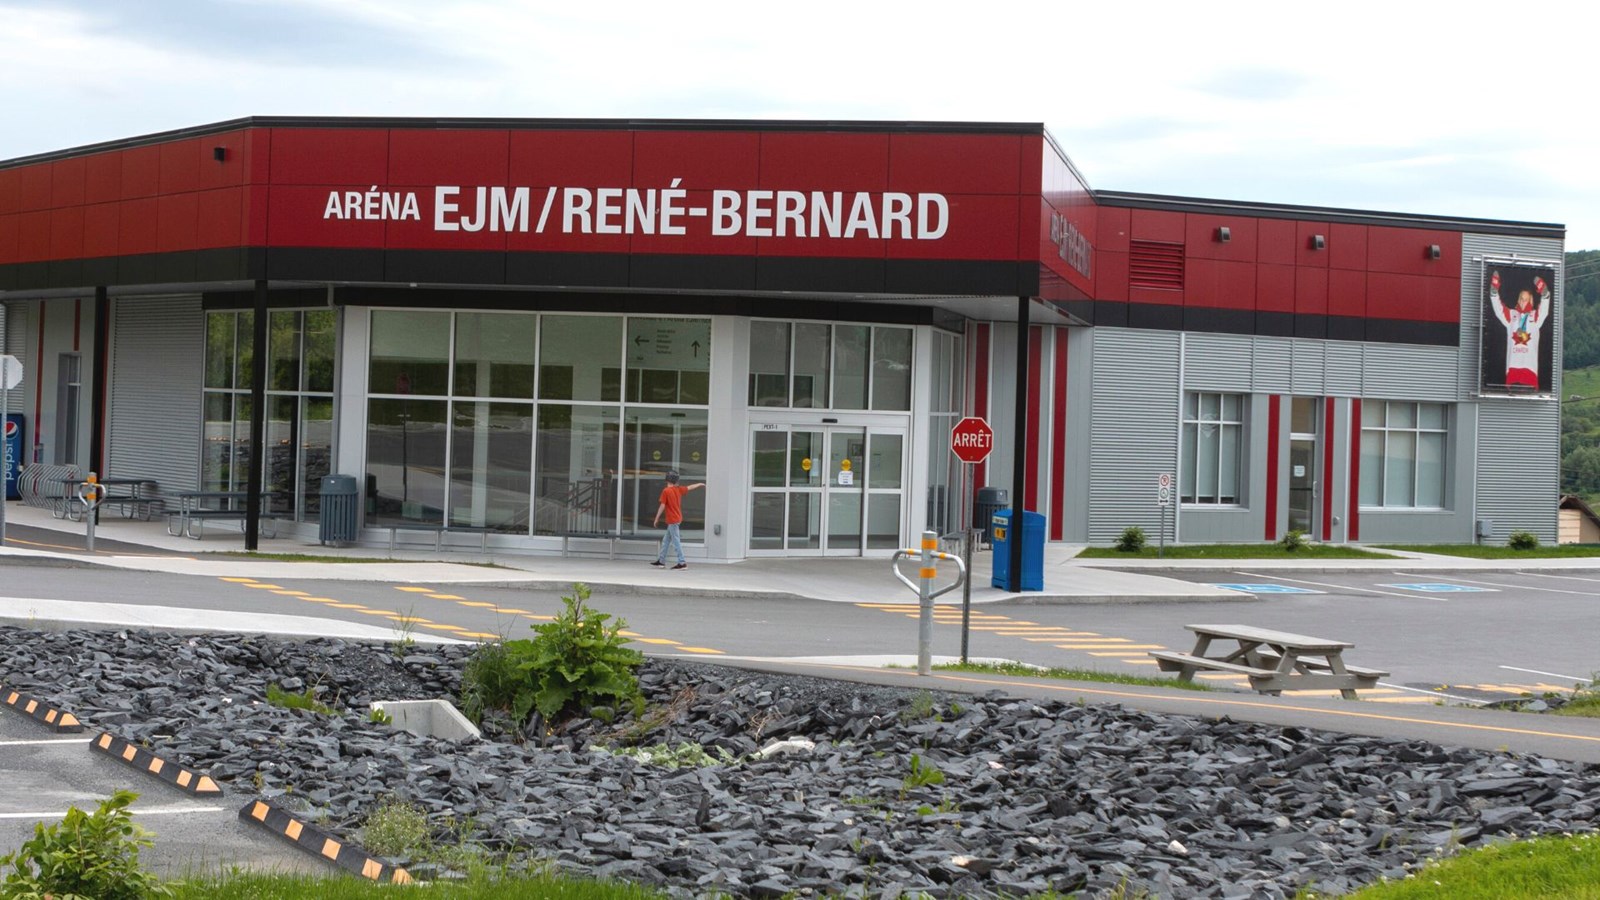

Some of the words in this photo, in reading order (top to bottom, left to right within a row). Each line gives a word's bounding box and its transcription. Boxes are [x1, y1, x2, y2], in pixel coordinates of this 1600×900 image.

[323, 185, 421, 220] ARÉNA
[954, 429, 991, 447] ARRÊT
[5, 443, 15, 480] pepsi
